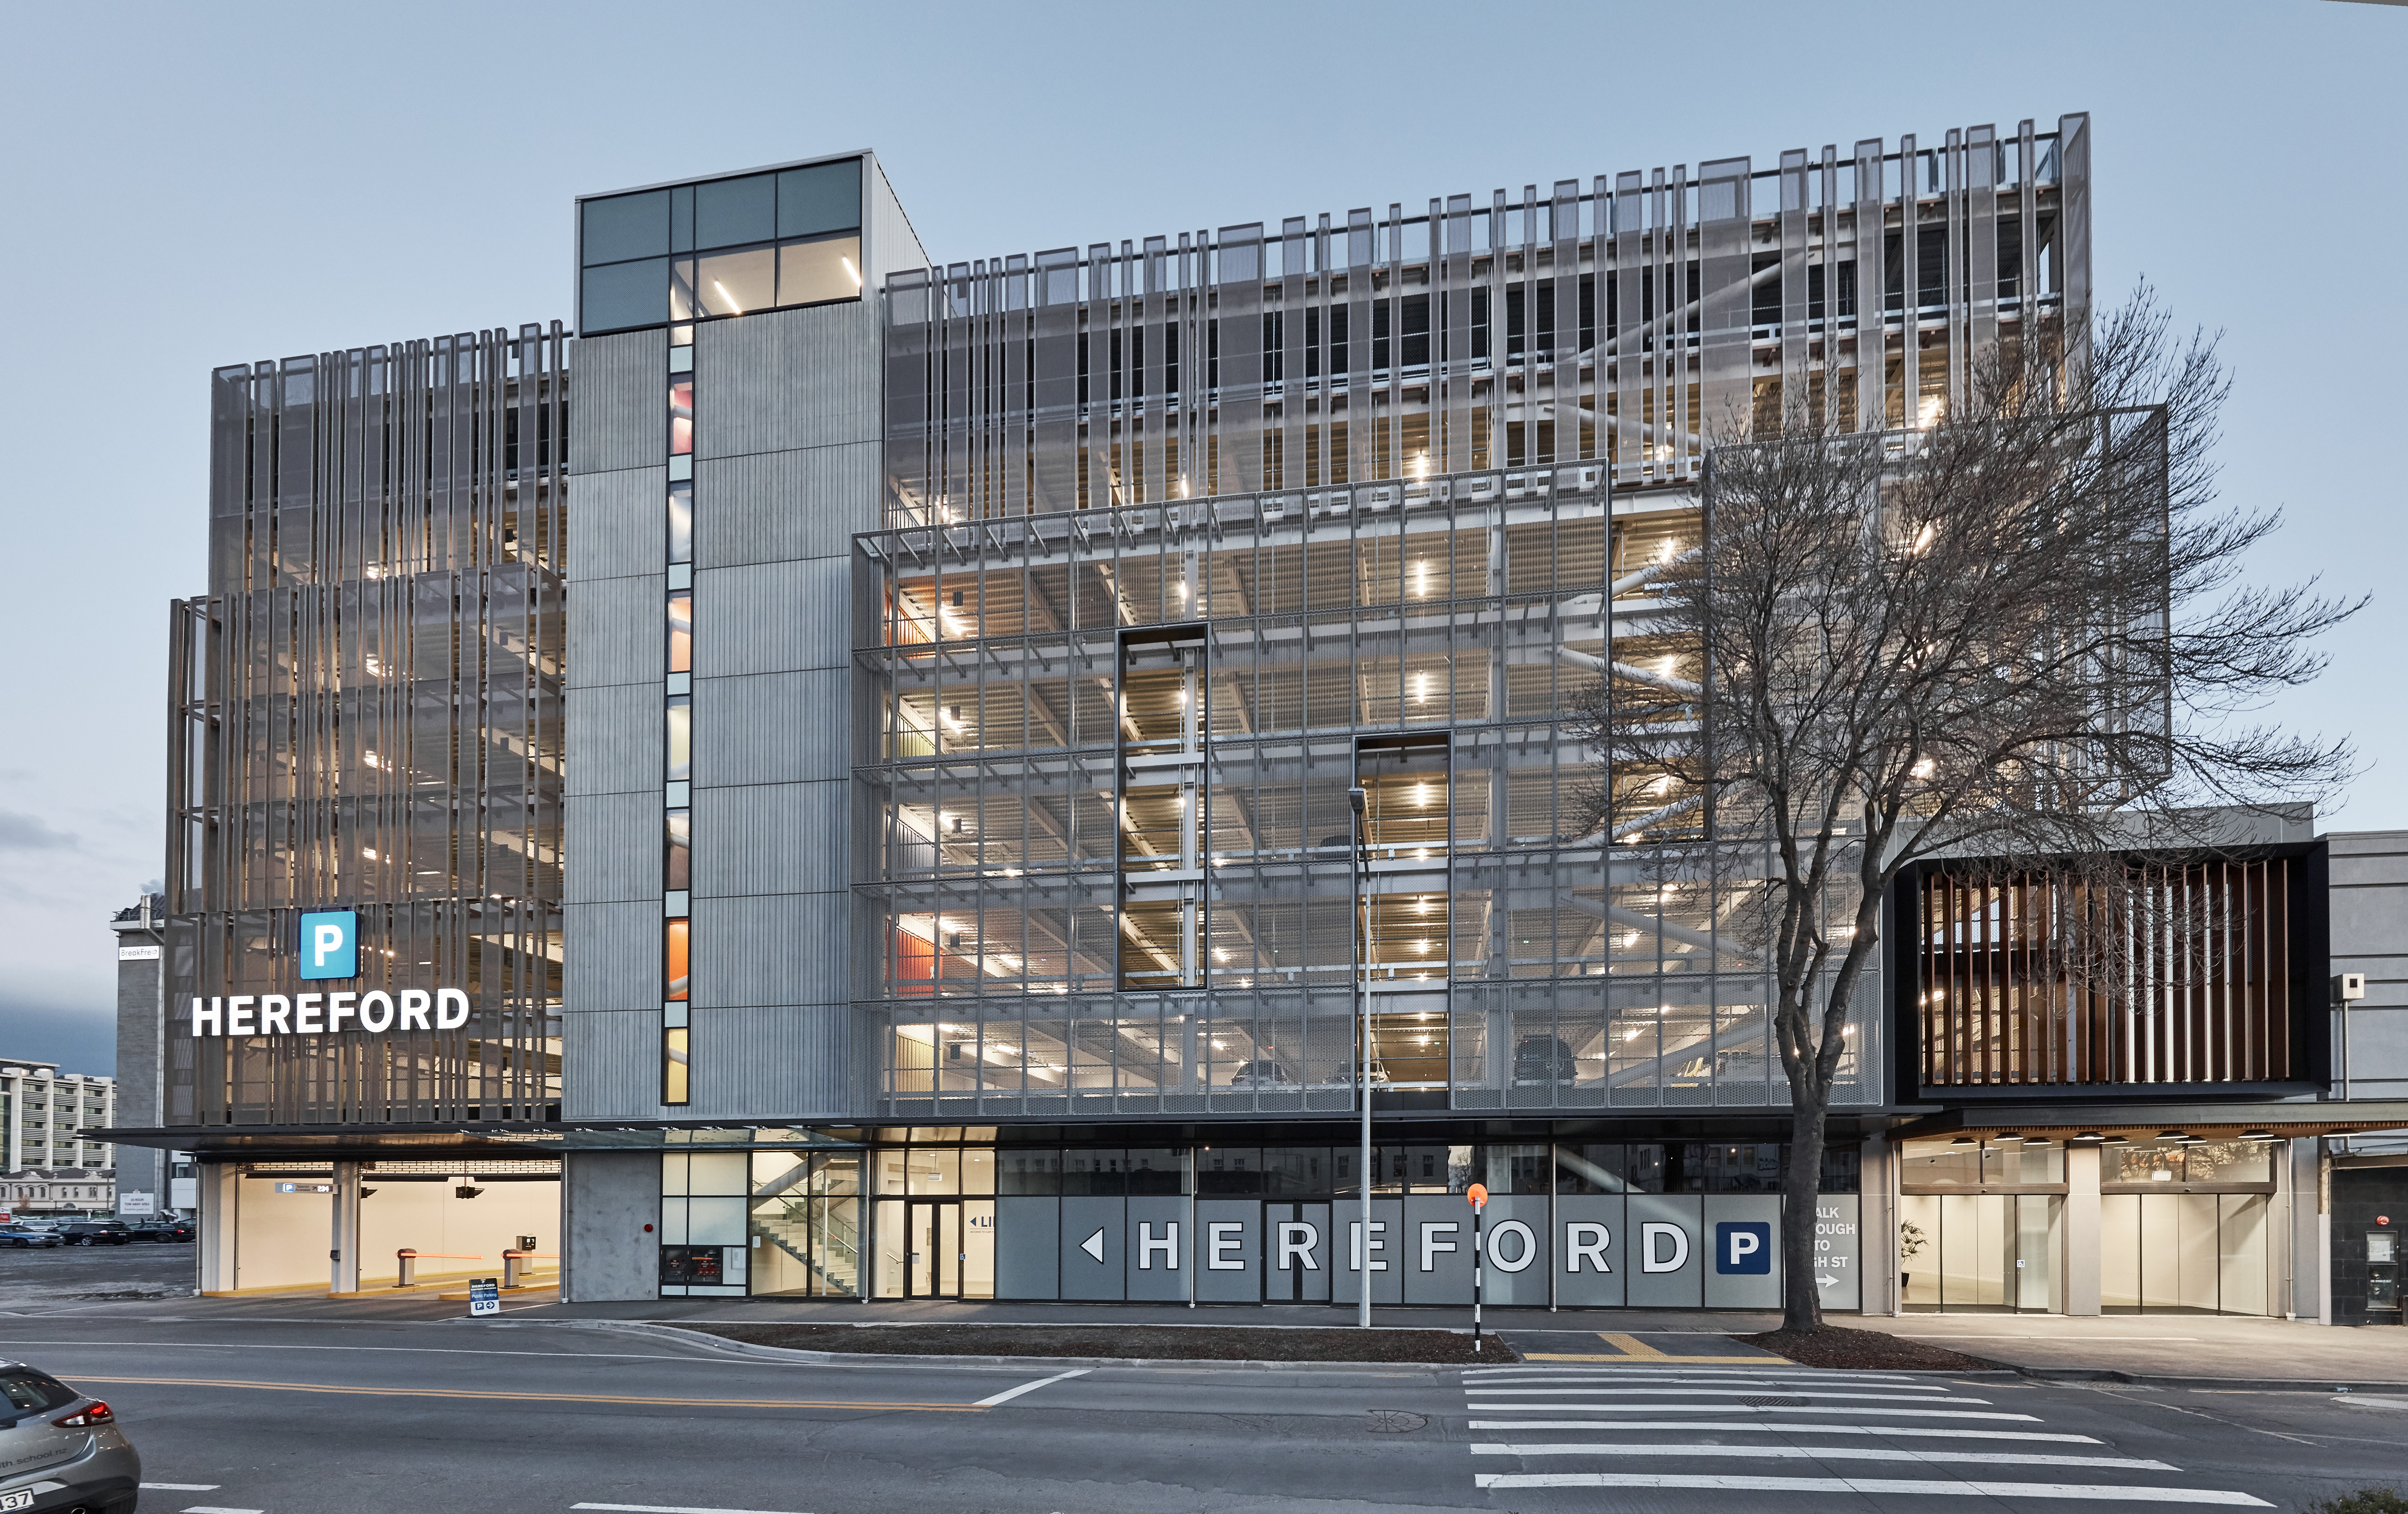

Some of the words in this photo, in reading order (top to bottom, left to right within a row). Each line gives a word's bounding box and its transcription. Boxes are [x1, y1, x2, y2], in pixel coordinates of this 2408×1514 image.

[315, 924, 343, 966] P
[192, 988, 469, 1036] HEREFORD
[1816, 1207, 1839, 1218] ALK
[981, 1216, 995, 1227] LI
[1815, 1223, 1855, 1235] OUGH
[1138, 1219, 1690, 1274] HEREFORD
[1730, 1232, 1759, 1264] P
[1814, 1239, 1830, 1251] TO
[1831, 1256, 1848, 1268] ST
